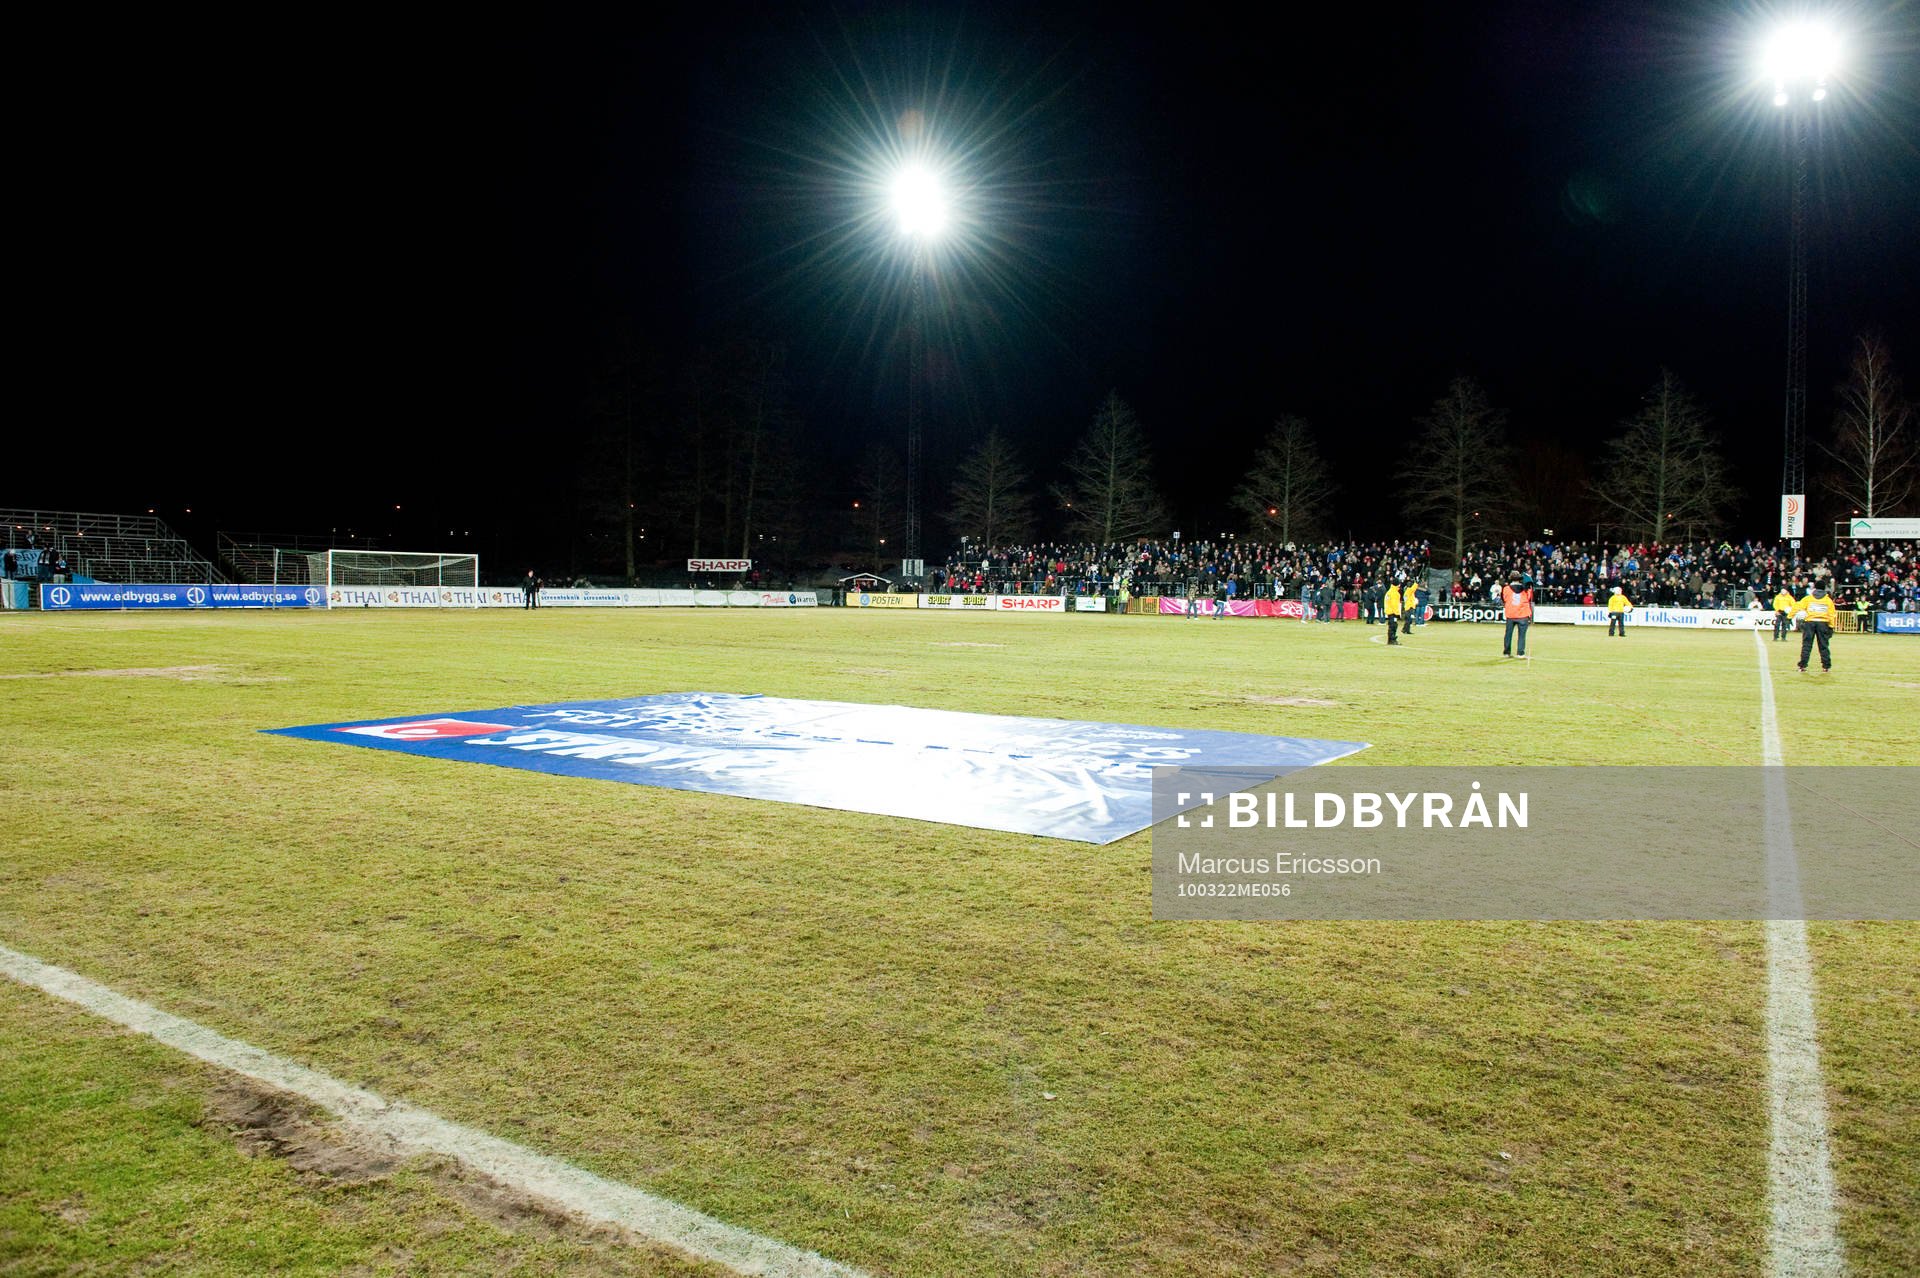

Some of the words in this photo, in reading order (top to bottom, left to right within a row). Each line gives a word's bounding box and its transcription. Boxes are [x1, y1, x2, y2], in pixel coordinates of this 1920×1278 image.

[1787, 516, 1795, 535] Bixia
[690, 560, 750, 570] SHARP
[80, 590, 177, 603] www.edbygg.se
[213, 591, 297, 603] www.edbygg.se
[343, 591, 382, 604] THAI
[400, 591, 436, 604] THAI
[928, 595, 951, 605] SPORT
[962, 596, 988, 606] SPORT
[1001, 598, 1060, 609] SHARP
[1581, 610, 1632, 622] Folkm
[1645, 611, 1697, 624] Folksam
[1711, 617, 1736, 626] NCC
[1885, 617, 1914, 628] HELA
